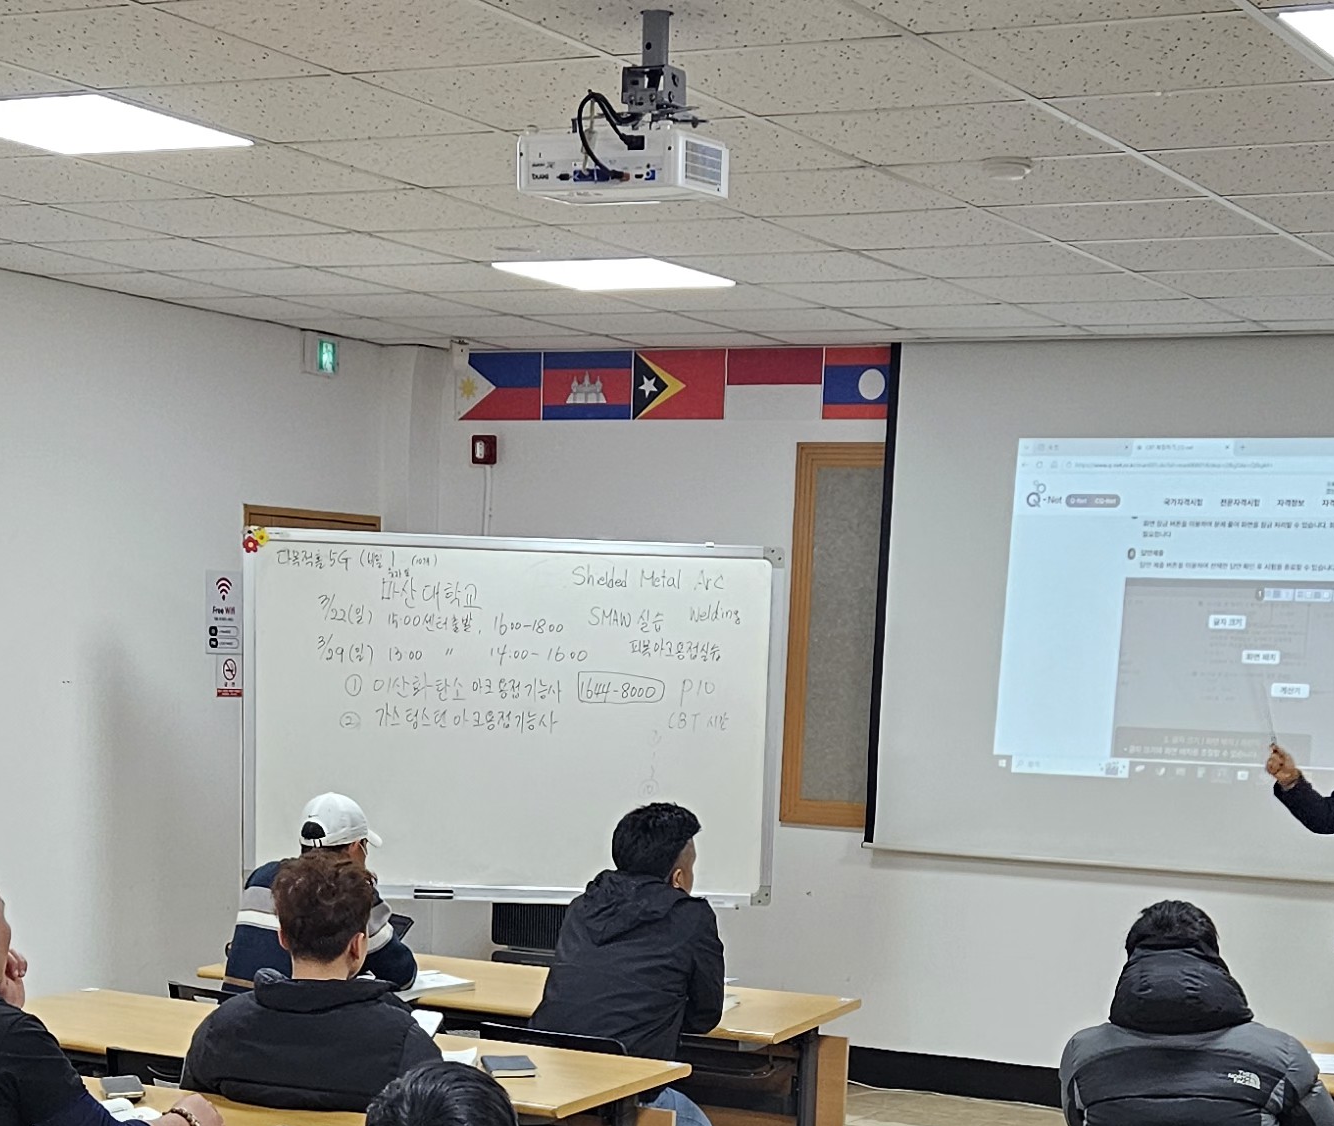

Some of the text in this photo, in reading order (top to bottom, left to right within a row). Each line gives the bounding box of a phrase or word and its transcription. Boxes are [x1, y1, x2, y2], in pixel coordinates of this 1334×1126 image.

[640, 568, 682, 590] Metal
[588, 606, 664, 633] SMAW 실습
[580, 678, 656, 703] 1644-8000
